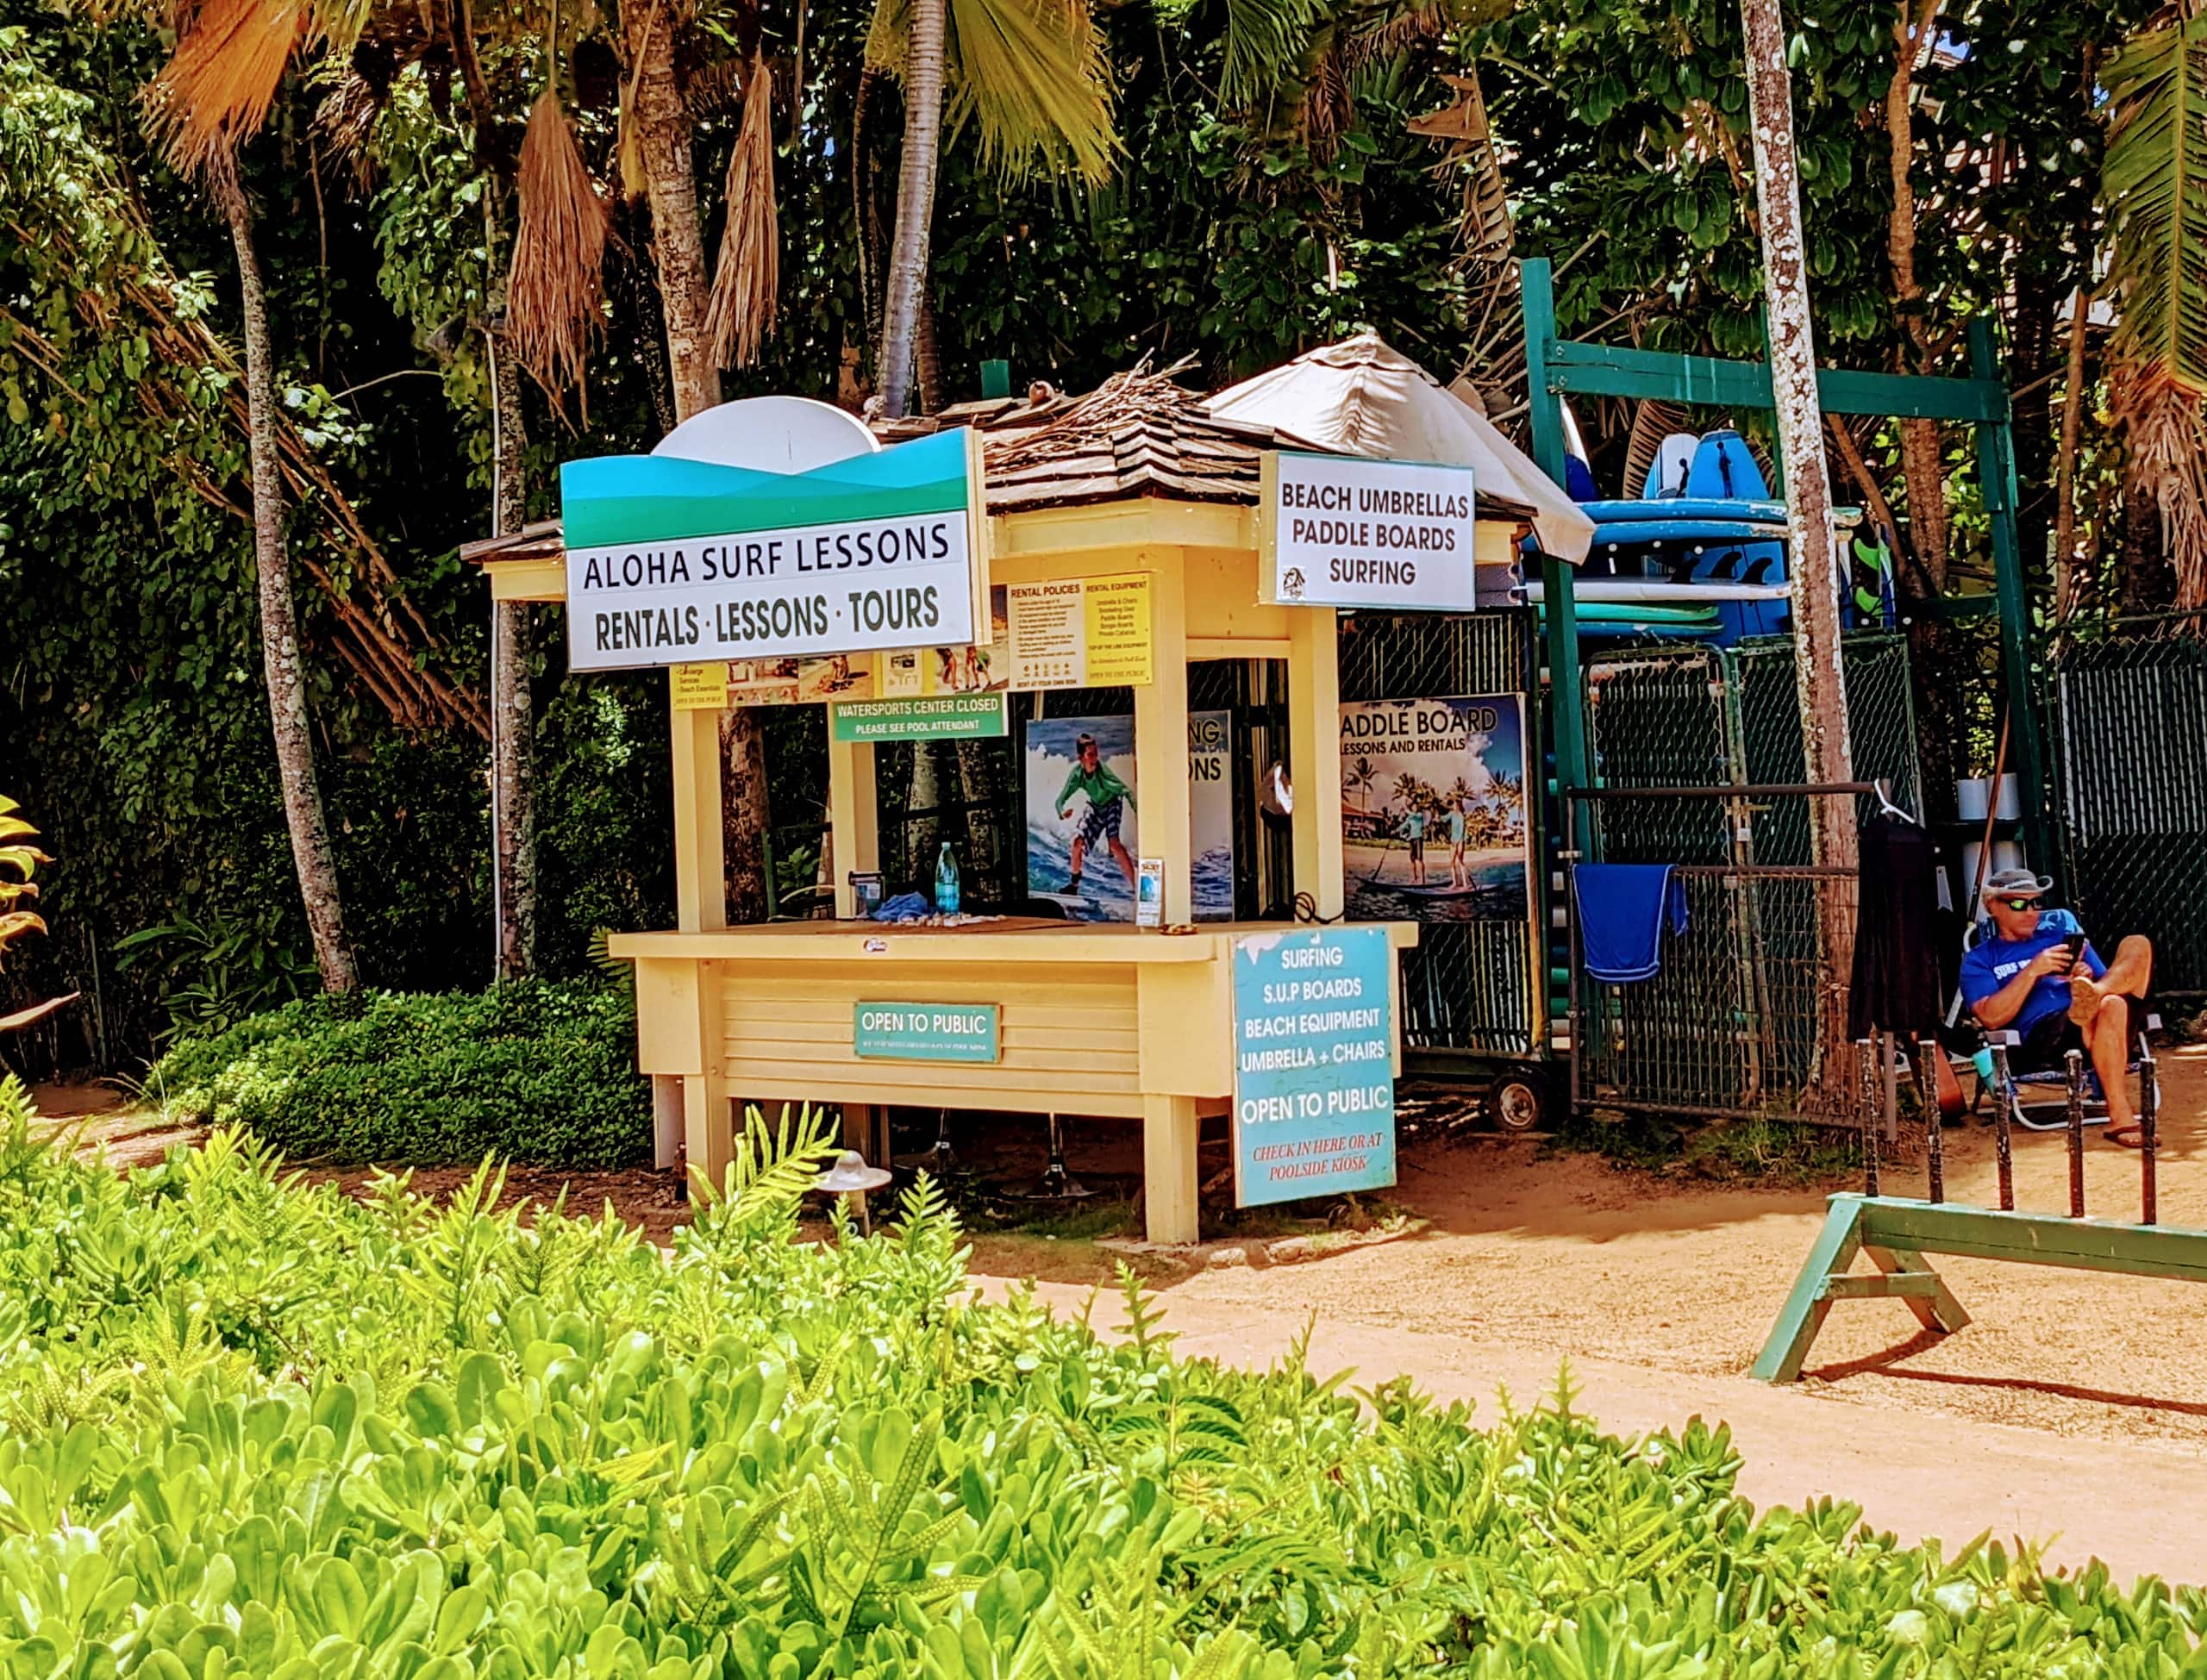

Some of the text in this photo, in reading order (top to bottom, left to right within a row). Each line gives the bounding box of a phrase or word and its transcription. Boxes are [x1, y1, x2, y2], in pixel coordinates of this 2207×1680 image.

[1282, 483, 1468, 519] BEACH UMBRELLAS
[1293, 519, 1455, 552] PADDLE BOARDS
[584, 523, 949, 589] ALOHA SURF LESSONS
[1330, 559, 1416, 585] SURFING
[1011, 584, 1080, 598] RENTAL POLICIES
[1086, 584, 1109, 593] RENTAL
[596, 585, 939, 652] RENTALS LESSONS TOURS
[837, 697, 998, 718] WATERSPORTS CENTER CLOSED
[855, 719, 979, 734] PLEASE SEE POOL ATTENDANT
[1417, 708, 1497, 734] BOARD
[1389, 740, 1415, 753] AND
[1418, 738, 1466, 753] RENTALS
[1189, 758, 1221, 781] NS
[1281, 946, 1343, 969] SURFING
[1264, 977, 1362, 1003] S.U.P BOARDS
[862, 1012, 987, 1034] OPEN TO PUBLIC
[1245, 1008, 1380, 1039] BEACH EQUIPMENT
[1241, 1047, 1316, 1072] UMBRELLA
[1333, 1040, 1385, 1063] CHAIRS
[1241, 1085, 1388, 1124] OPEN TO PUBLIC
[1254, 1132, 1384, 1162] CHECK IN HERE OR AT
[1269, 1155, 1368, 1181] POOLSIDE KIOSK
